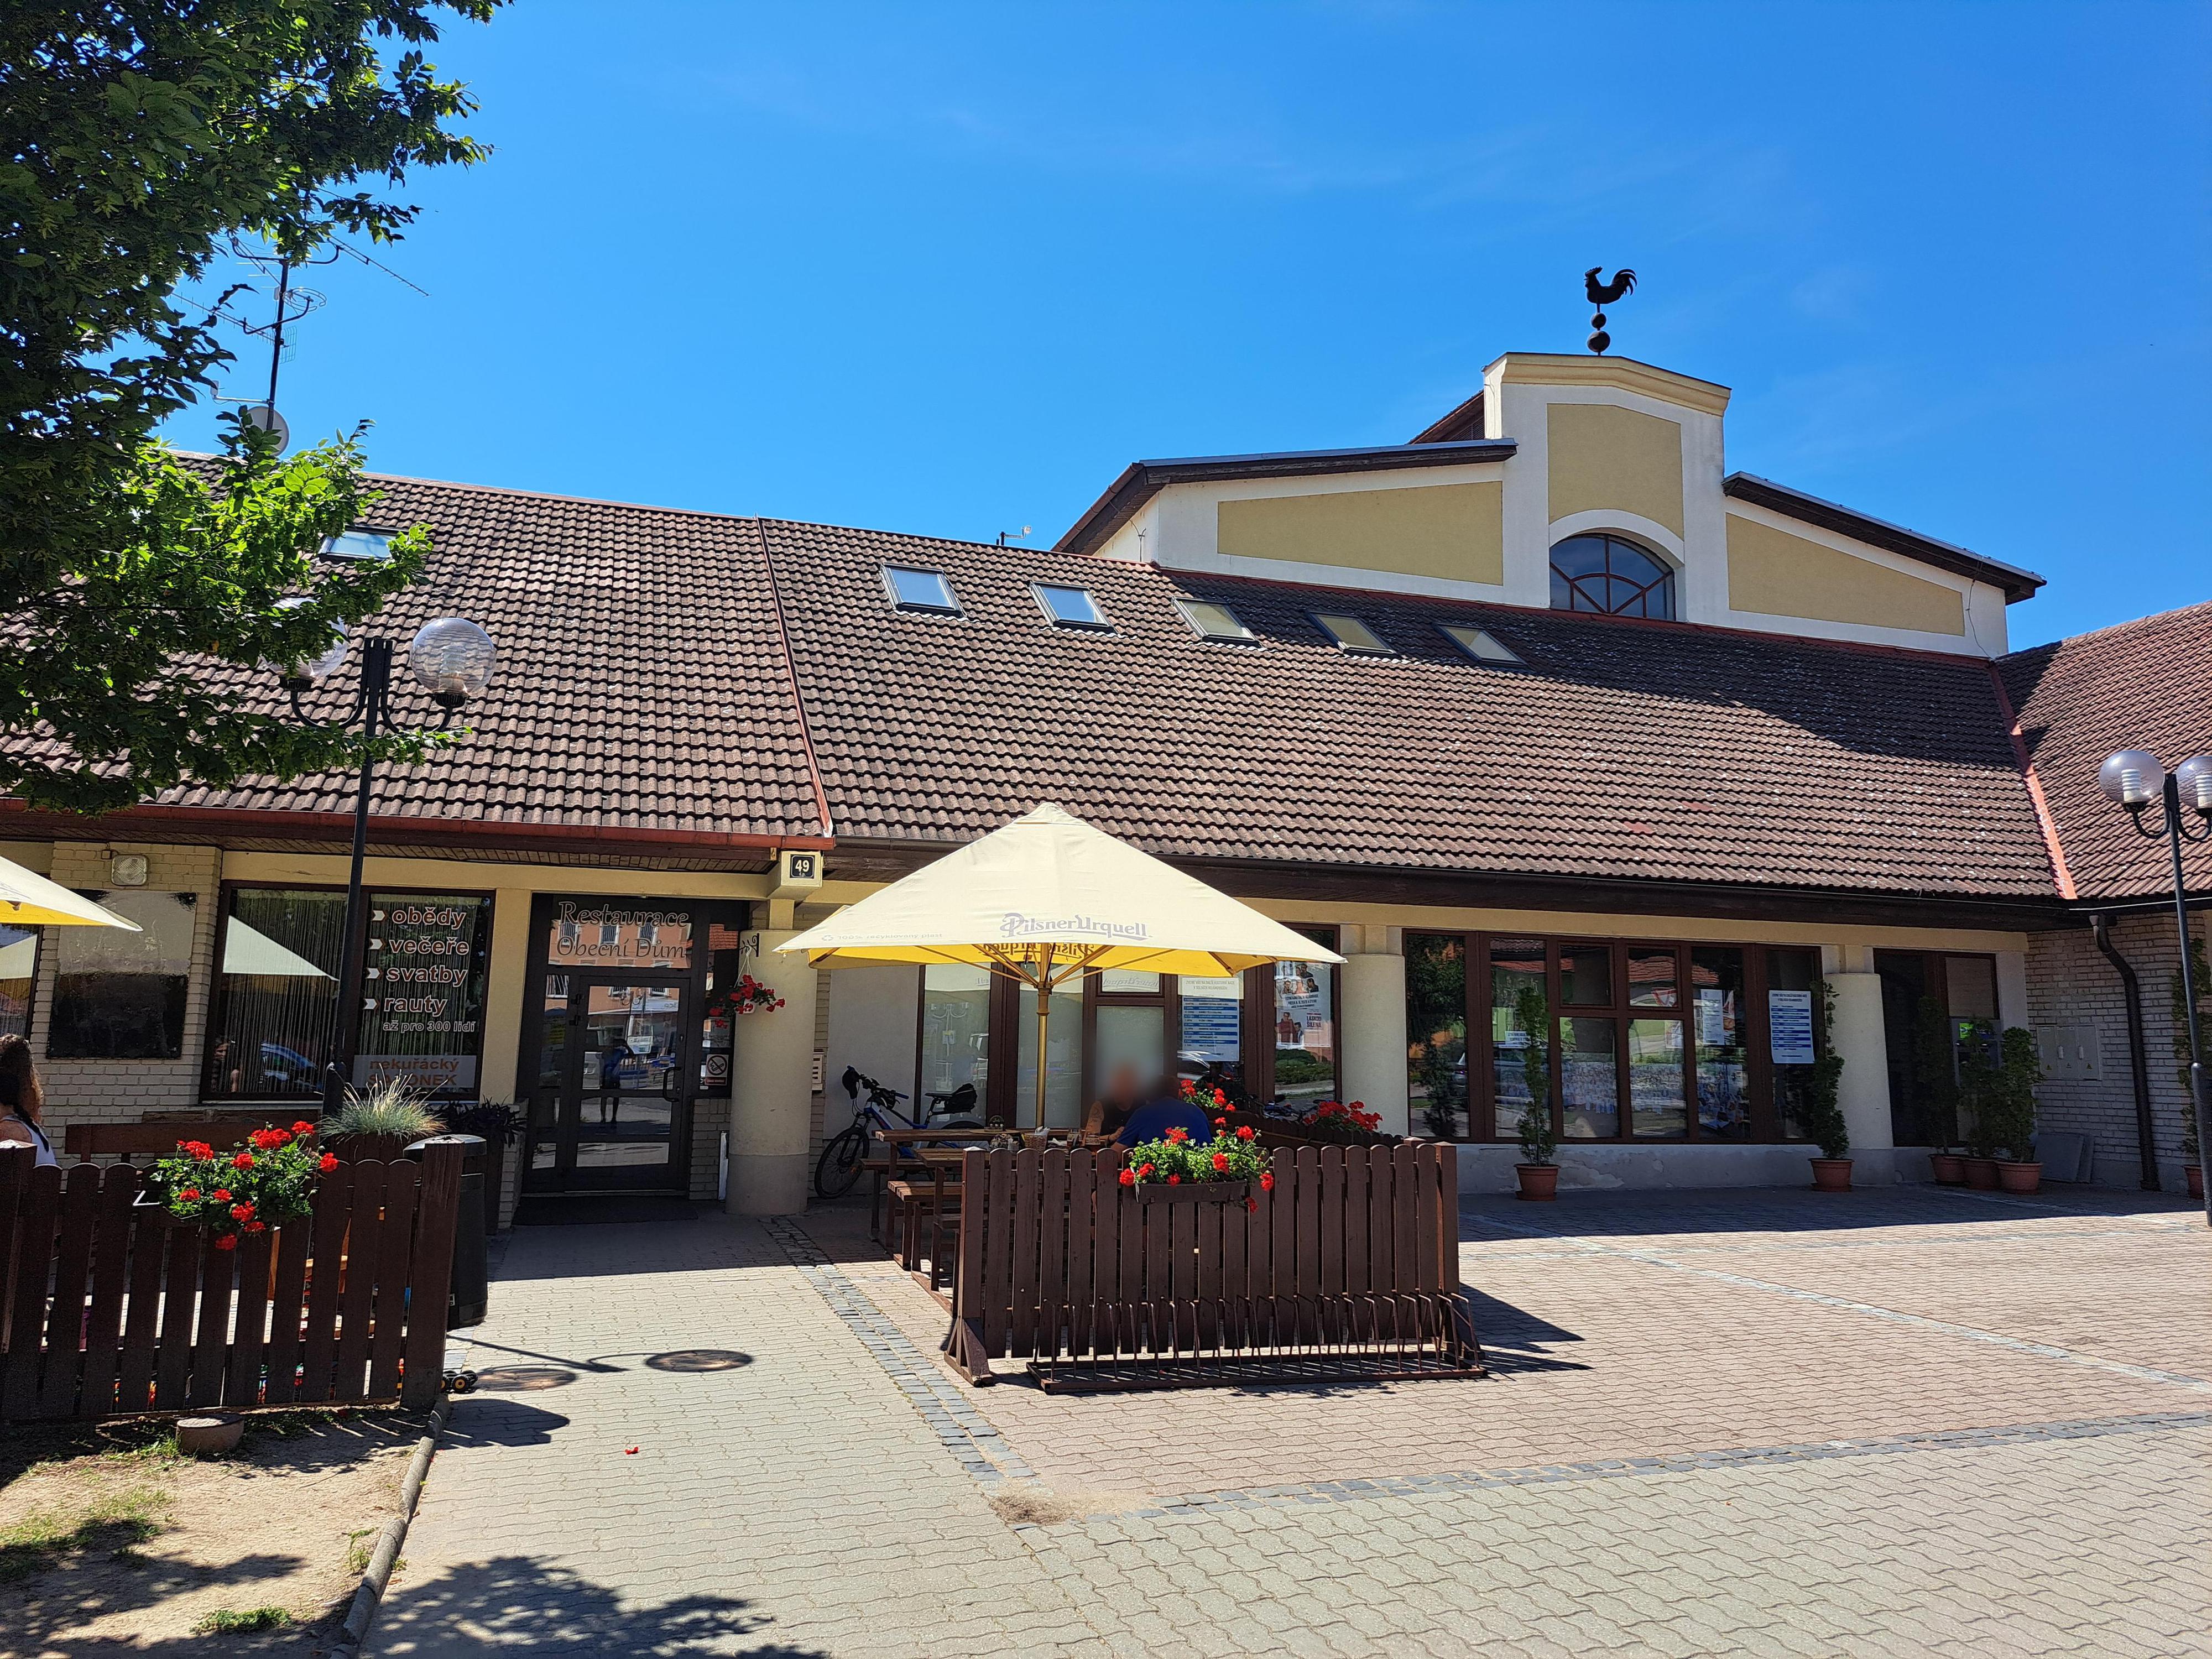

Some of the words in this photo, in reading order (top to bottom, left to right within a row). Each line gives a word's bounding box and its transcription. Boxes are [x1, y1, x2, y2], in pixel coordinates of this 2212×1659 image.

[795, 859, 810, 872] 49
[392, 906, 466, 930] obědy
[559, 901, 689, 928] Restaurace
[1000, 912, 1077, 938] Pilsner
[1074, 914, 1147, 939] Urquell
[389, 936, 469, 955] večeře
[557, 936, 629, 957] Obecní
[635, 938, 687, 958] Dům
[386, 965, 468, 987] svatby
[384, 995, 448, 1017] rauty
[383, 1020, 399, 1031] až
[401, 1022, 424, 1033] pro
[426, 1021, 451, 1031] 300
[453, 1021, 476, 1032] lidí
[369, 1058, 460, 1072] nekuřácký
[369, 1074, 457, 1086] SAONEK
